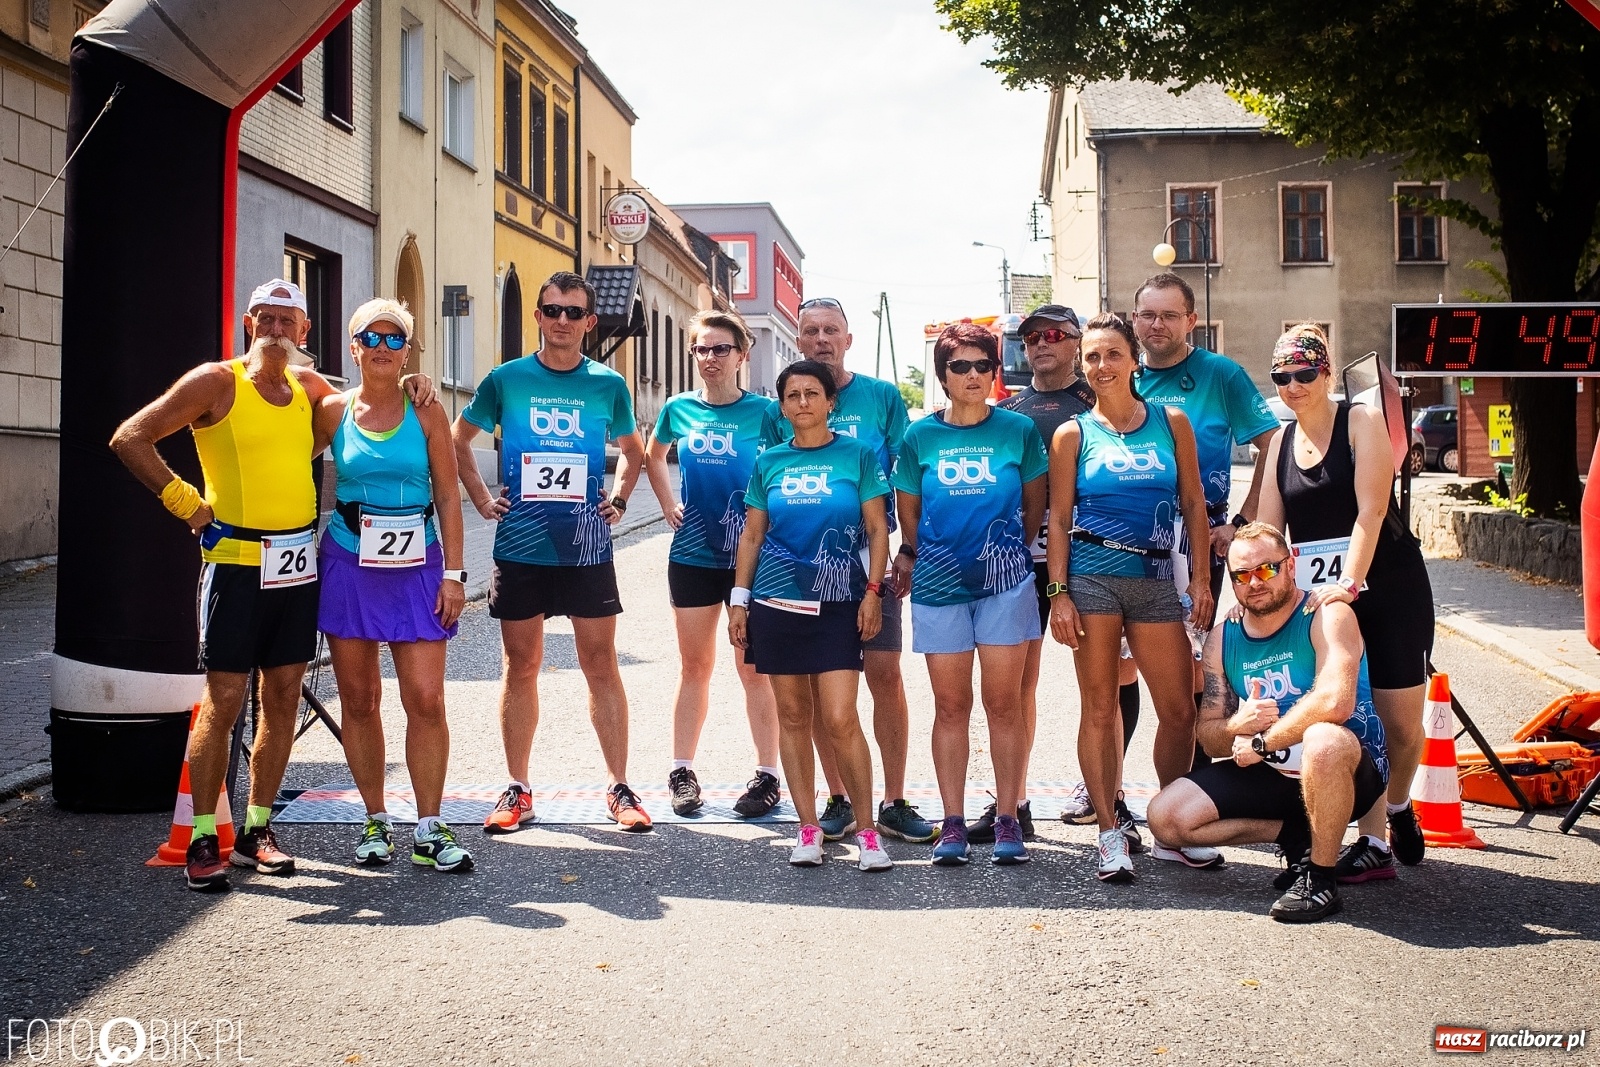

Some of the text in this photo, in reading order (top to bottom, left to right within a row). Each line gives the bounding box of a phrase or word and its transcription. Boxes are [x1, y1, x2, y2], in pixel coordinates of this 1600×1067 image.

[611, 214, 644, 224] TYSKIE
[529, 407, 585, 439] bbl
[540, 439, 574, 449] RACIBÓRZ
[688, 429, 738, 458] bbl
[696, 457, 728, 466] RACIBÓRZ
[937, 456, 997, 486] bbl
[536, 466, 571, 490] 34
[781, 472, 833, 496] bbl
[1118, 474, 1156, 482] RACIBÓRZ
[786, 497, 822, 505] RACIBÓRZ
[949, 487, 986, 497] RACIBÓRZ
[377, 530, 415, 556] 27
[277, 546, 307, 576] 26
[1310, 554, 1343, 585] 24
